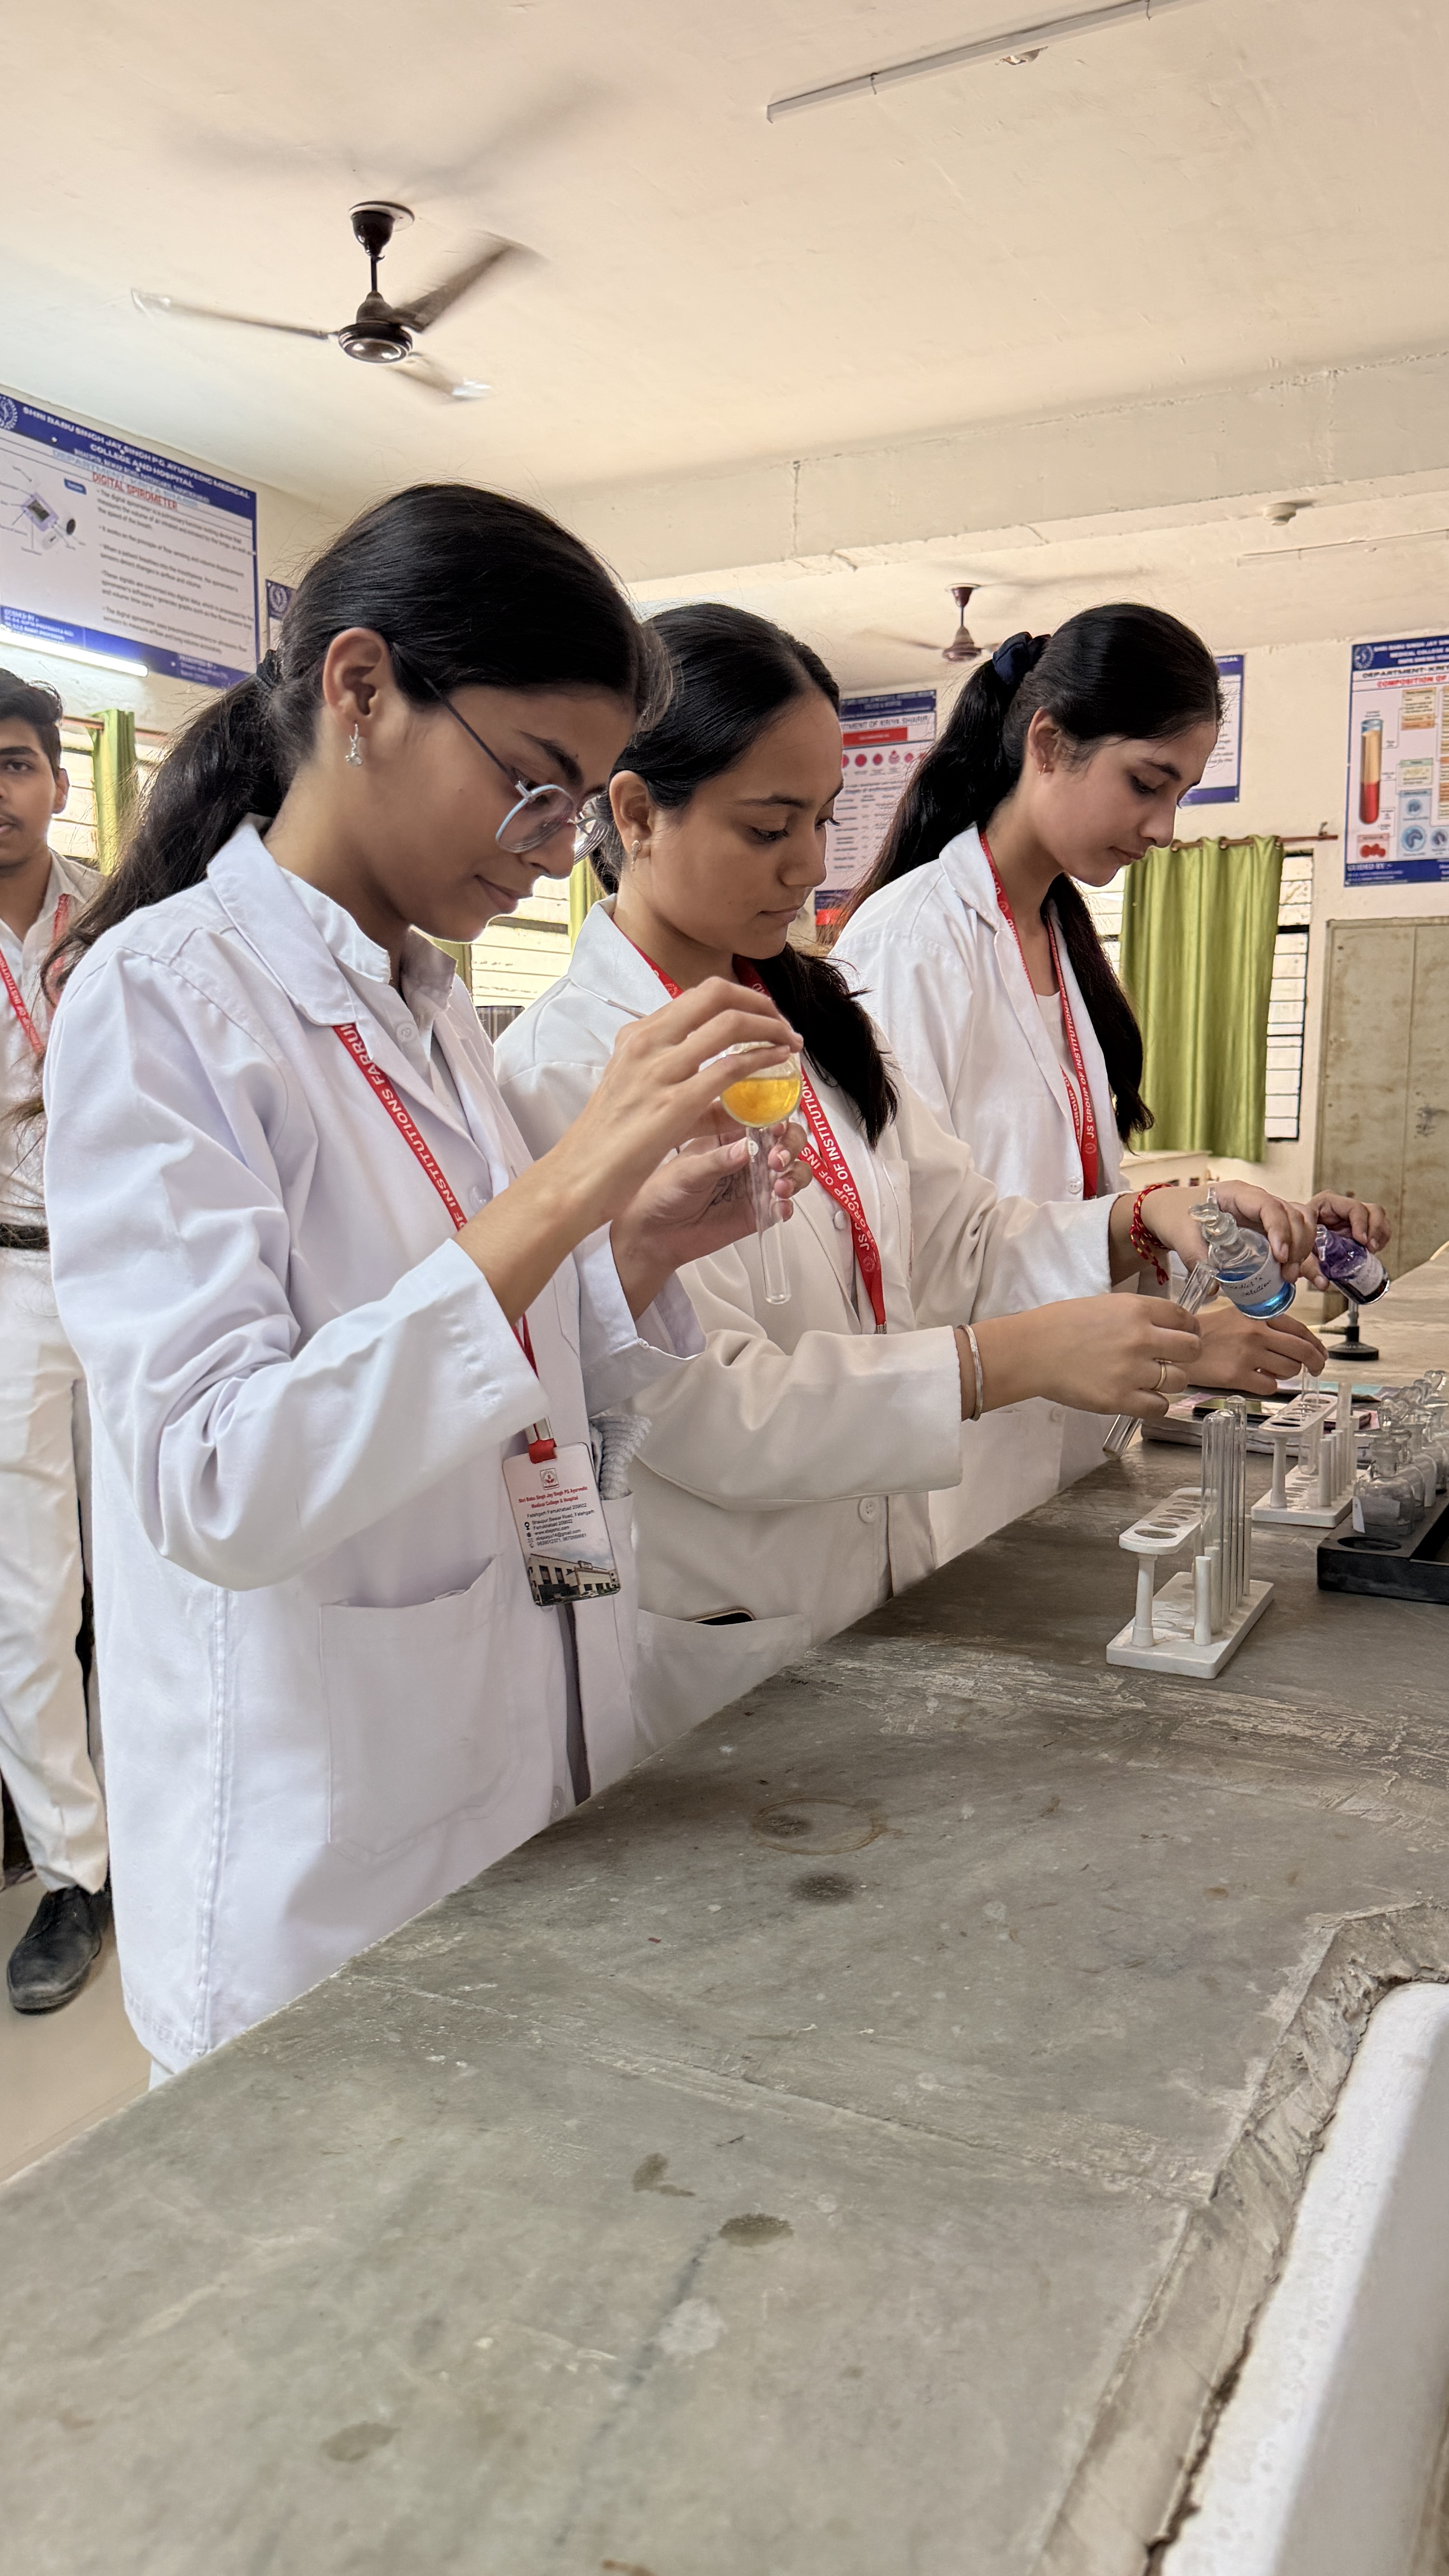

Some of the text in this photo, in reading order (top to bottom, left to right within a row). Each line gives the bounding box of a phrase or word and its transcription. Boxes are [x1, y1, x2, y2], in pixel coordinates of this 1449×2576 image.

[75, 428, 104, 444] SINGH
[90, 443, 131, 465] COLLEGE
[153, 466, 194, 488] HOSPITAL
[92, 471, 125, 492] DIGITAL
[127, 484, 177, 510] SPIROMETER
[1377, 677, 1433, 688] COMPOSITION
[1063, 998, 1083, 1070] INSTITUTIONS
[1078, 1072, 1086, 1083] OF
[801, 1075, 841, 1161] INSTITUTION
[1068, 1089, 1080, 1126] GROUP
[1083, 1087, 1093, 1122] GROUP
[381, 1089, 456, 1207] INSTITUTIONS
[1086, 1125, 1095, 1139] JS
[819, 1171, 834, 1186] OF
[833, 1164, 848, 1180] OF
[834, 1188, 866, 1228] GROUP
[858, 1233, 869, 1251] JS
